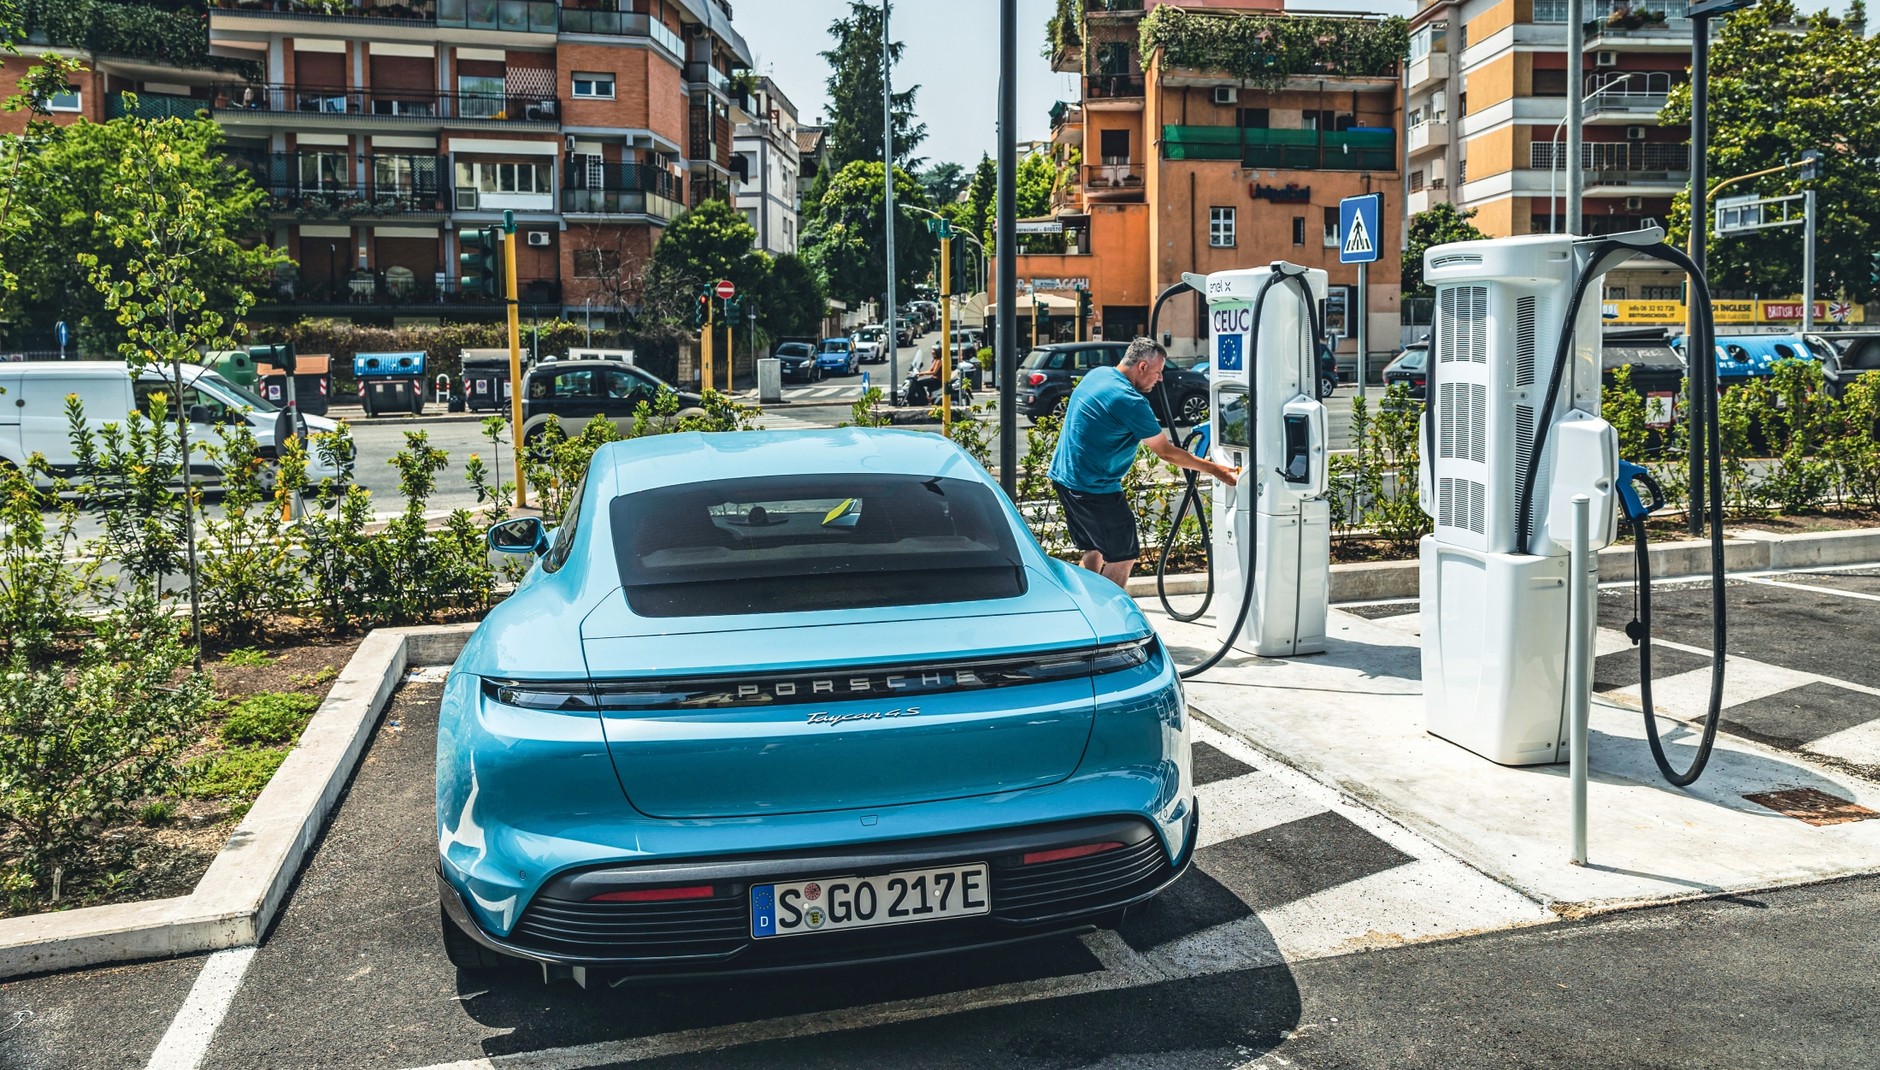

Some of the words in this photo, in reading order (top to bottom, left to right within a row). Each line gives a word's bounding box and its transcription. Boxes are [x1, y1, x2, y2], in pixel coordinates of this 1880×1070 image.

[1210, 279, 1223, 293] enel
[1720, 304, 1752, 312] INGLESE
[1767, 305, 1793, 318] BRITISH
[1794, 305, 1822, 317] SCOL
[1214, 308, 1249, 333] CEUC
[738, 670, 975, 697] PORSCHE
[807, 711, 882, 727] Taycan
[884, 706, 921, 717] 4S
[778, 888, 803, 929] S
[887, 869, 986, 918] 217E
[760, 916, 769, 927] D
